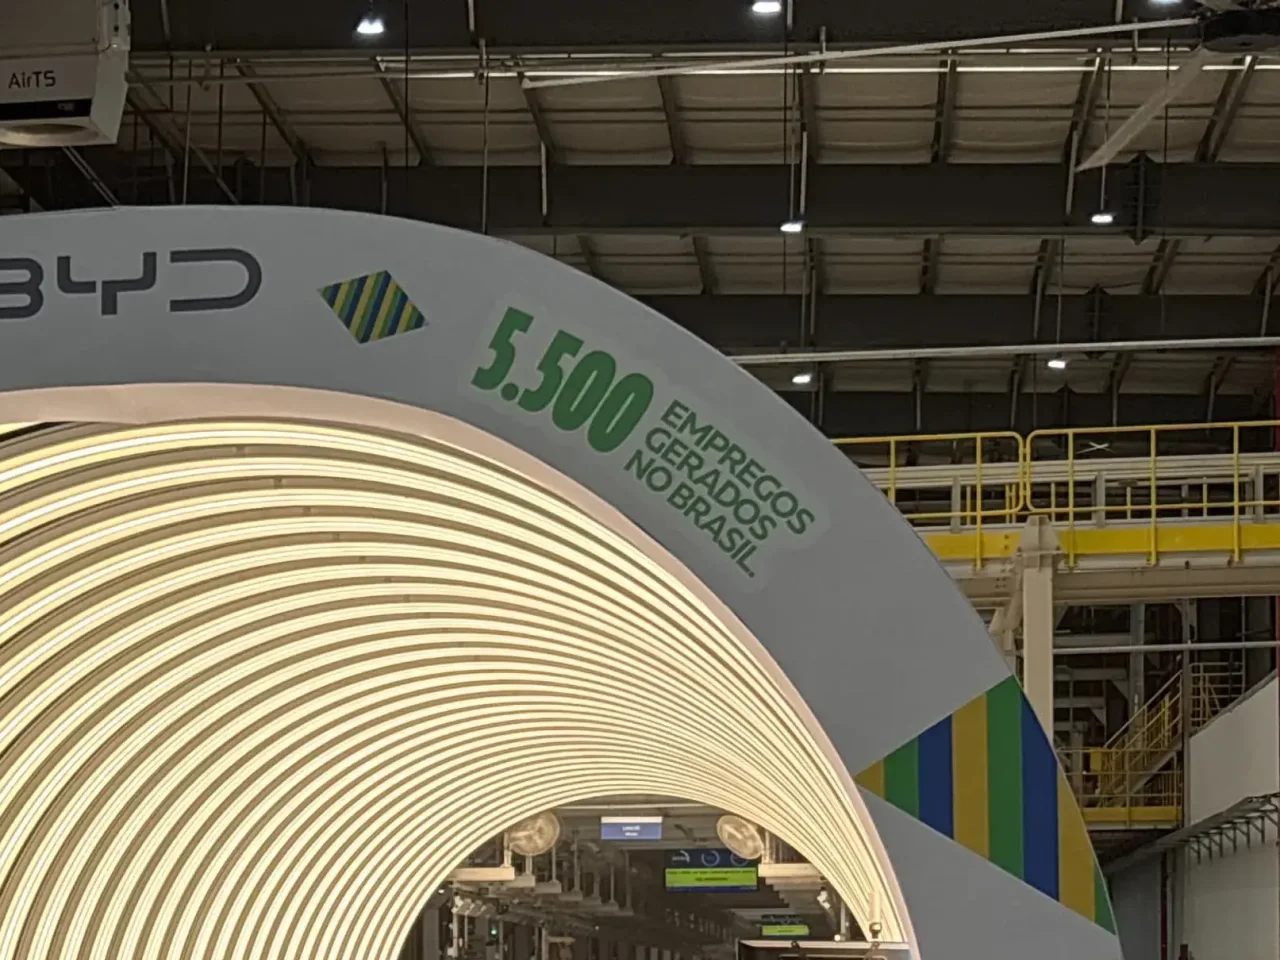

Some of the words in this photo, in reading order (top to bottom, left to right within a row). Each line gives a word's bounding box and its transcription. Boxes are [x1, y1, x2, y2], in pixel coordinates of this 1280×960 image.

[7, 70, 57, 89] AirTS
[471, 306, 654, 454] 5.500
[623, 449, 672, 492] NO
[666, 481, 758, 578] BRASIL.
[645, 427, 777, 541] GERADOS
[660, 399, 815, 535] EMPREGOS
